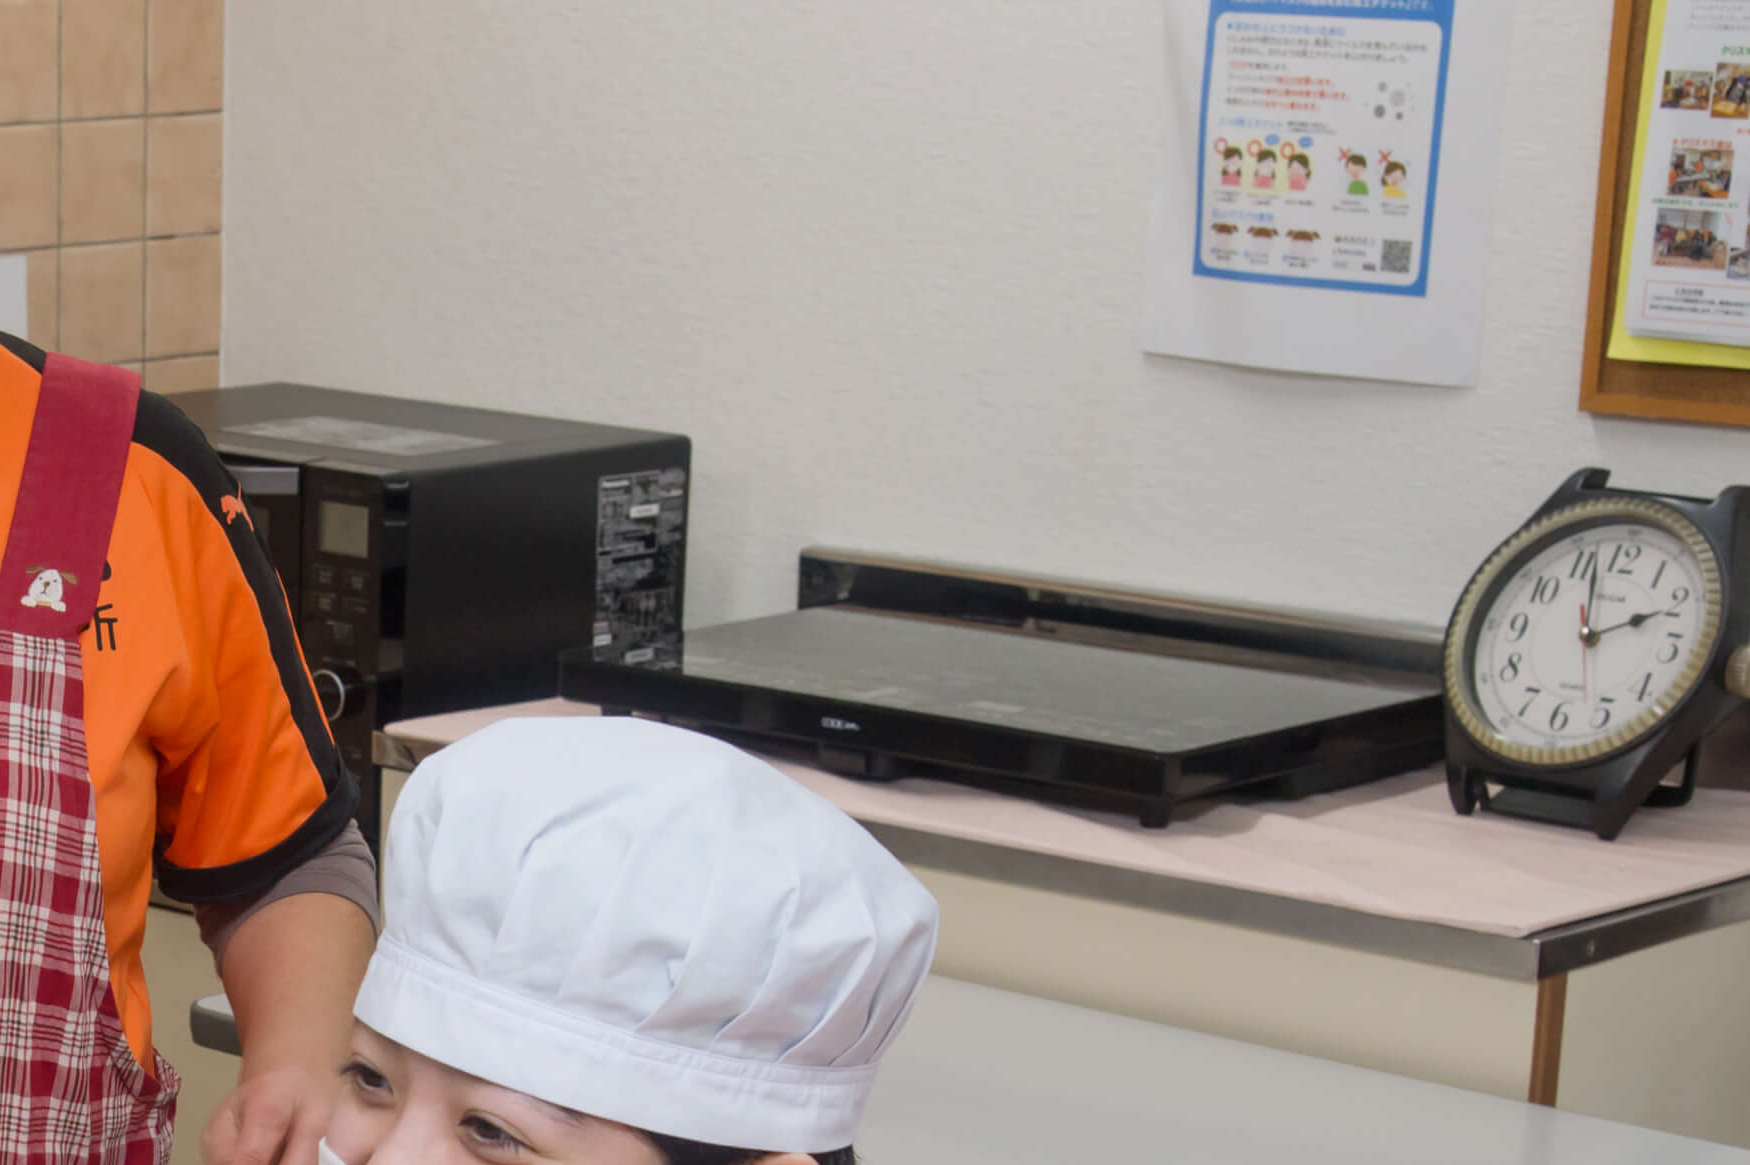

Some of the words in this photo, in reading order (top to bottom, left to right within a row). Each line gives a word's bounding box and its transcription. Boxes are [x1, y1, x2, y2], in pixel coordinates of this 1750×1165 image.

[1569, 550, 1596, 581] 11
[1607, 543, 1642, 576] 12
[1651, 559, 1667, 590] 1
[1529, 575, 1561, 605] 10
[1663, 586, 1690, 618] 2
[1509, 612, 1529, 642] 9
[1655, 632, 1683, 665] 3
[1499, 652, 1522, 683] 8
[1518, 687, 1542, 718] 7
[1627, 671, 1653, 703] 4
[1550, 701, 1571, 732] 6
[1589, 697, 1616, 730] 5
